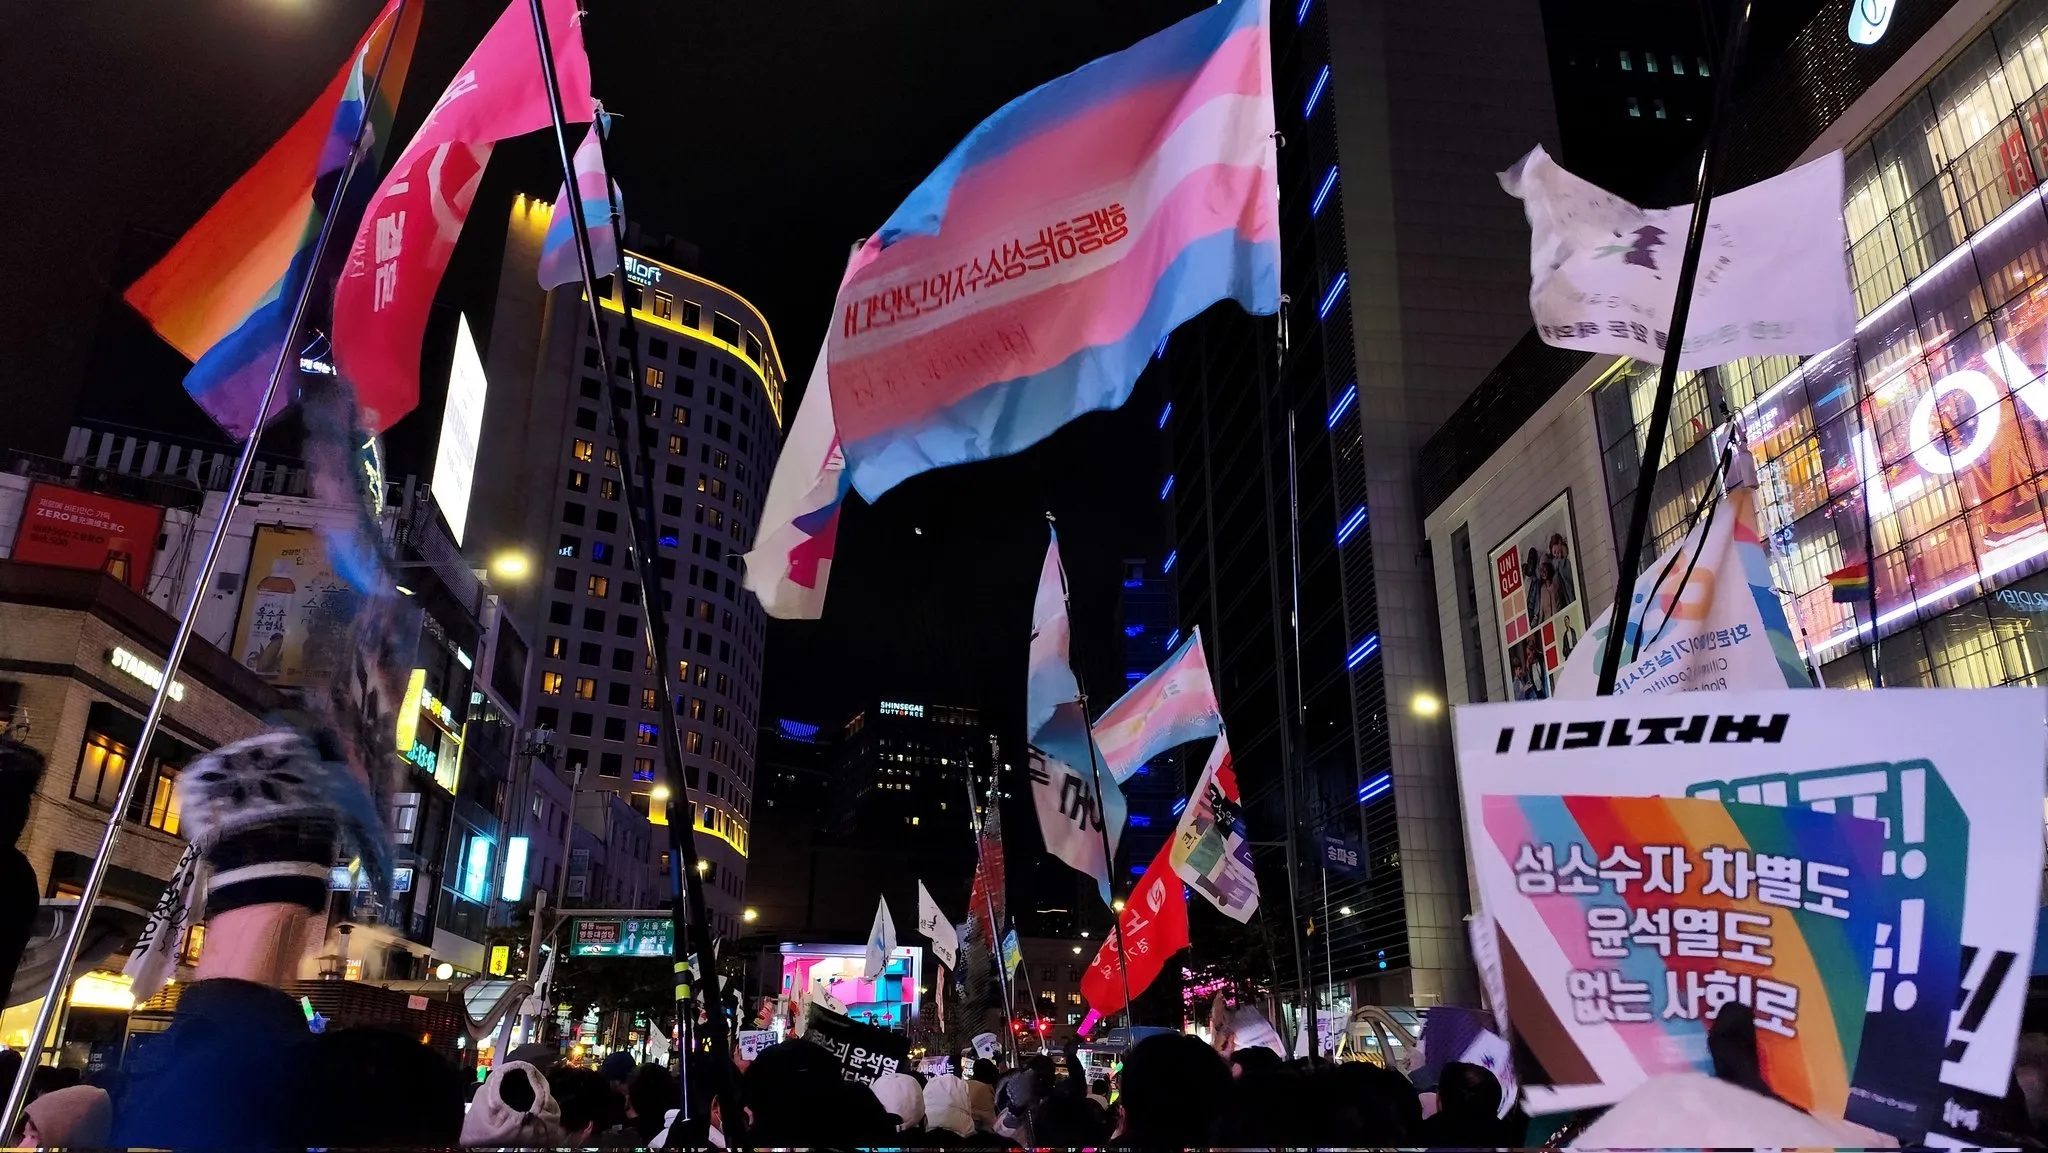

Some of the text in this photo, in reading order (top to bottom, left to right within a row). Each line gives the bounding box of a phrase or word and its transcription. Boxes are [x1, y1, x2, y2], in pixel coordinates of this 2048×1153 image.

[1499, 554, 1516, 576] UNI
[1502, 568, 1519, 594] QLO
[255, 606, 287, 620] 옥수수
[254, 619, 283, 632] 수염차
[880, 701, 924, 712] SHINSEGAE
[880, 708, 924, 717] DUTY FREE
[1514, 843, 1851, 920] 성소수자 차별도
[579, 931, 615, 939] 명동대성당
[581, 922, 595, 930] 명동
[1586, 906, 1774, 967] 윤석열도
[1567, 969, 1800, 1039] 없는 사회로
[849, 1046, 900, 1077] 윤석열
